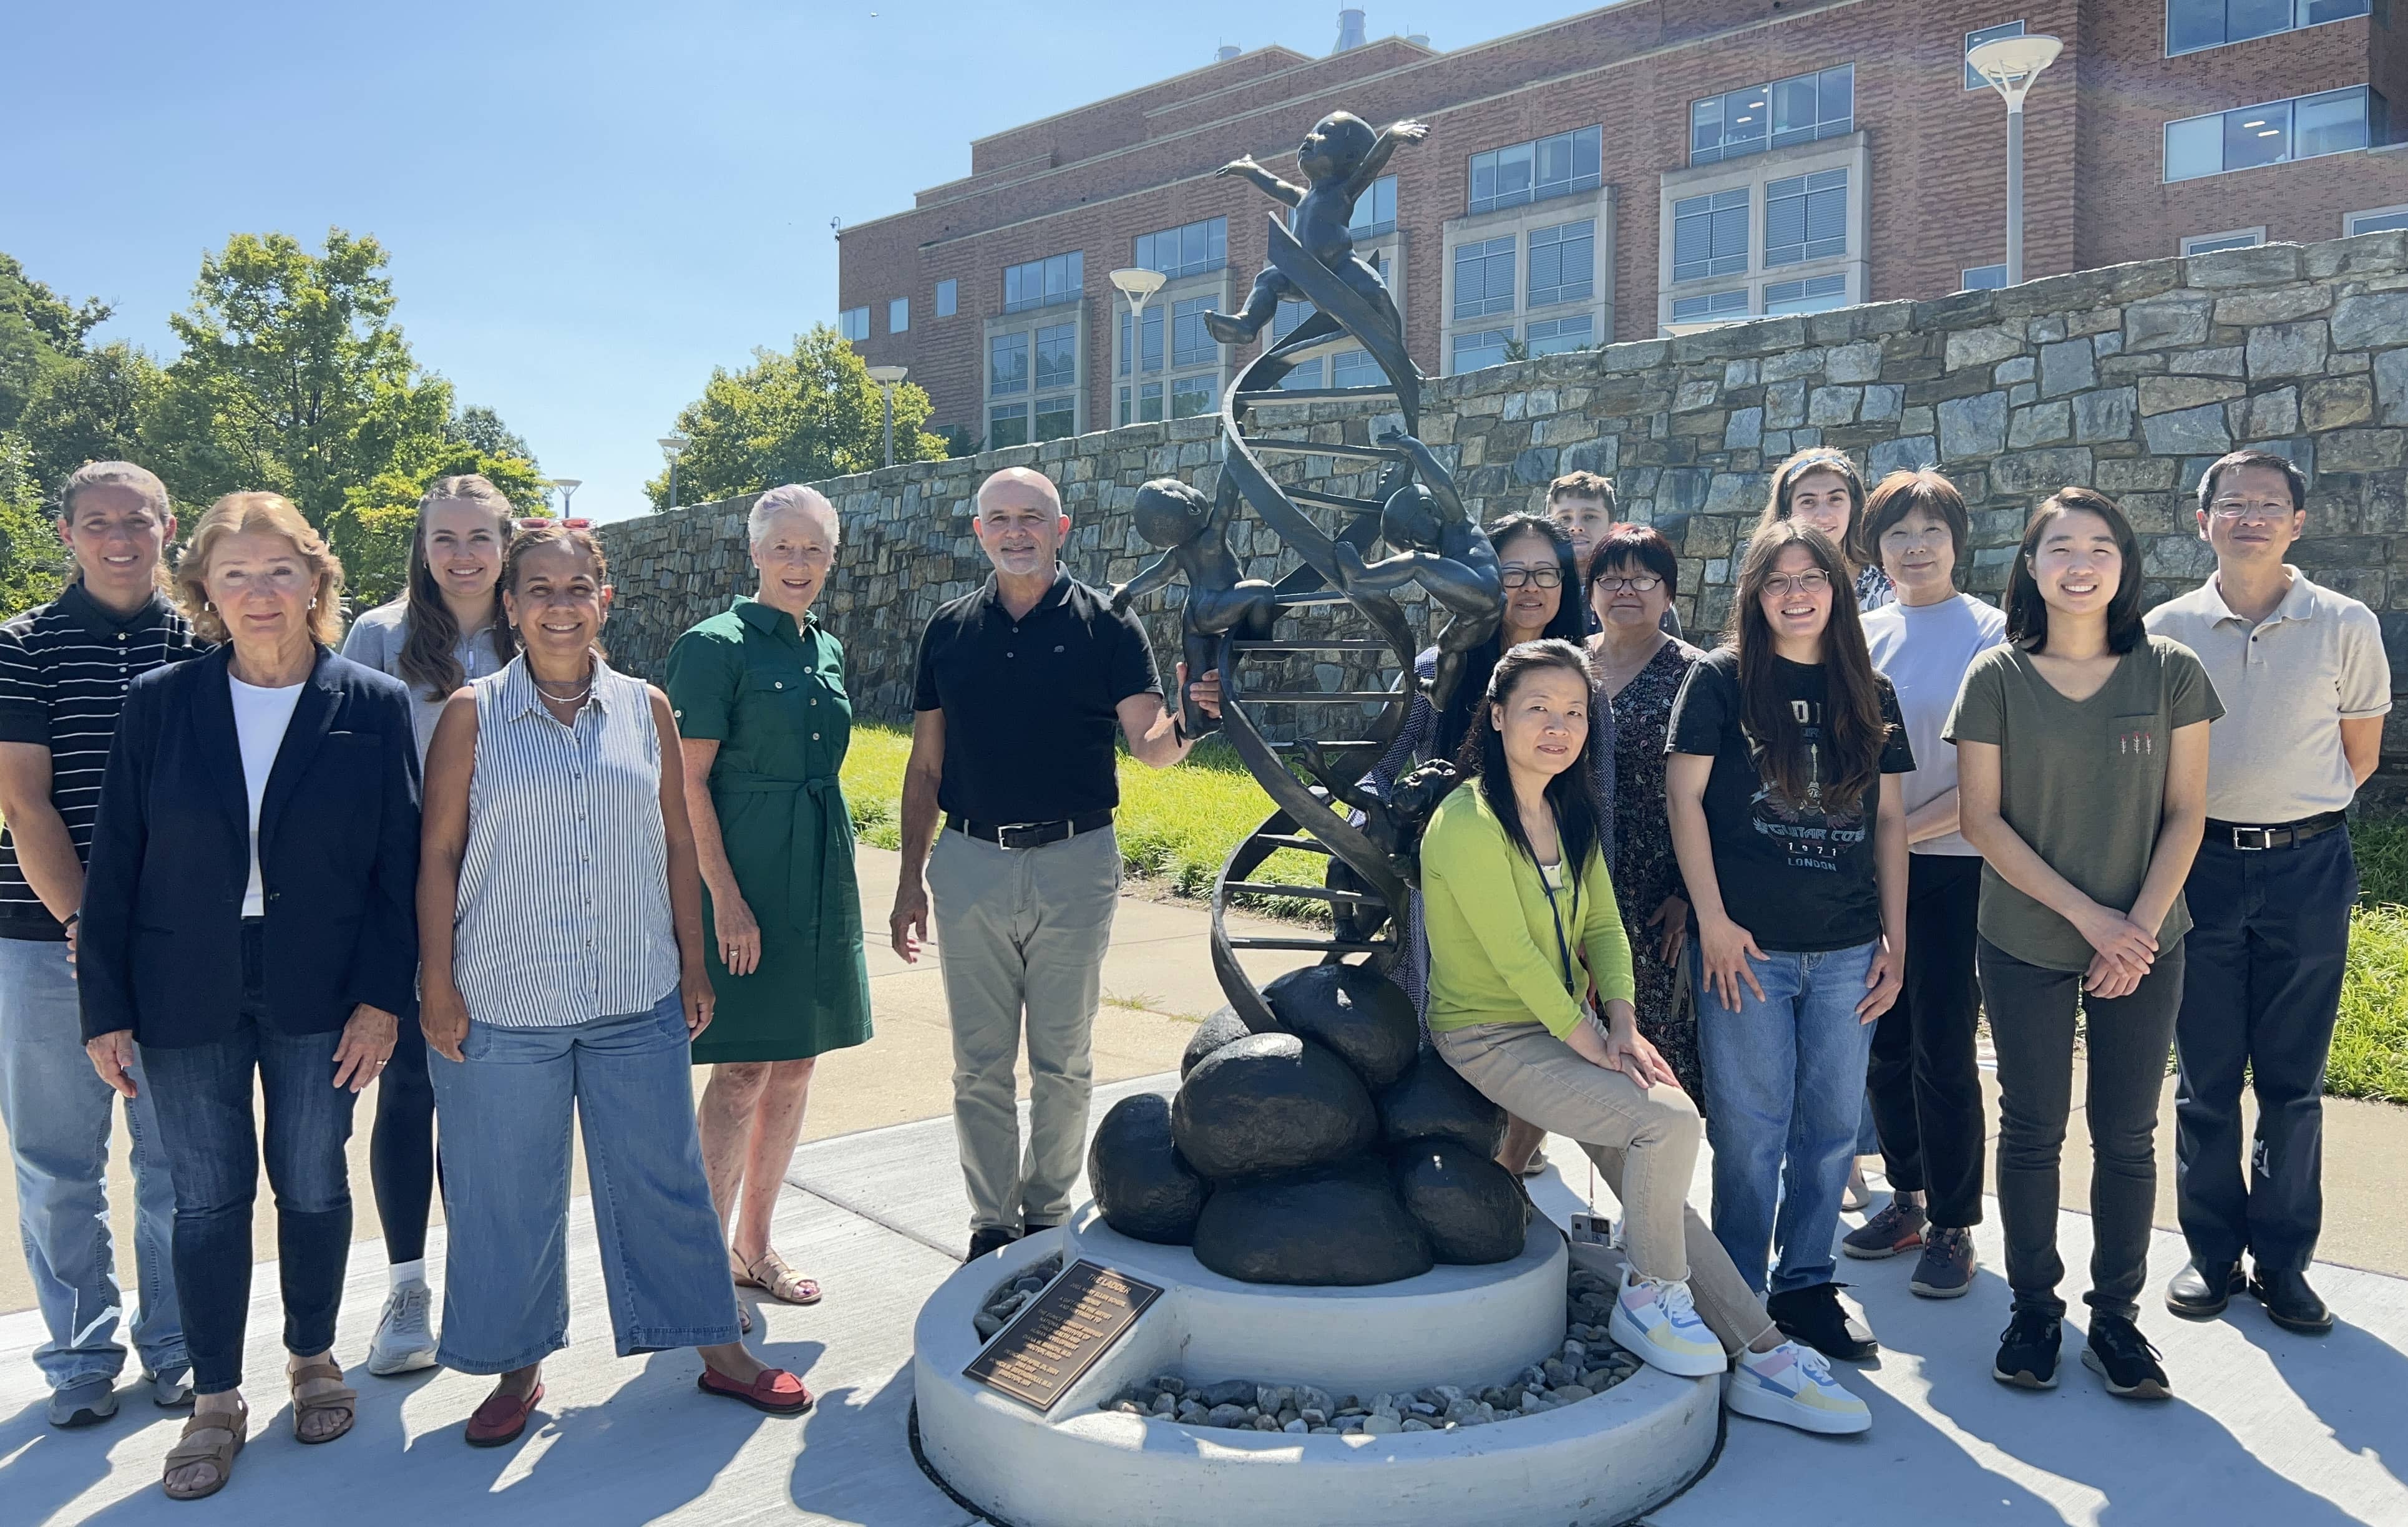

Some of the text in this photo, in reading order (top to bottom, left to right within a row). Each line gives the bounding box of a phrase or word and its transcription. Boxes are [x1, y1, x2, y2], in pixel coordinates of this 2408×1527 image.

[1768, 824, 1856, 842] GUITAR CO
[1788, 842, 1836, 857] 1971
[1787, 857, 1837, 872] LONDON
[1088, 1274, 1133, 1294] THE LADDER
